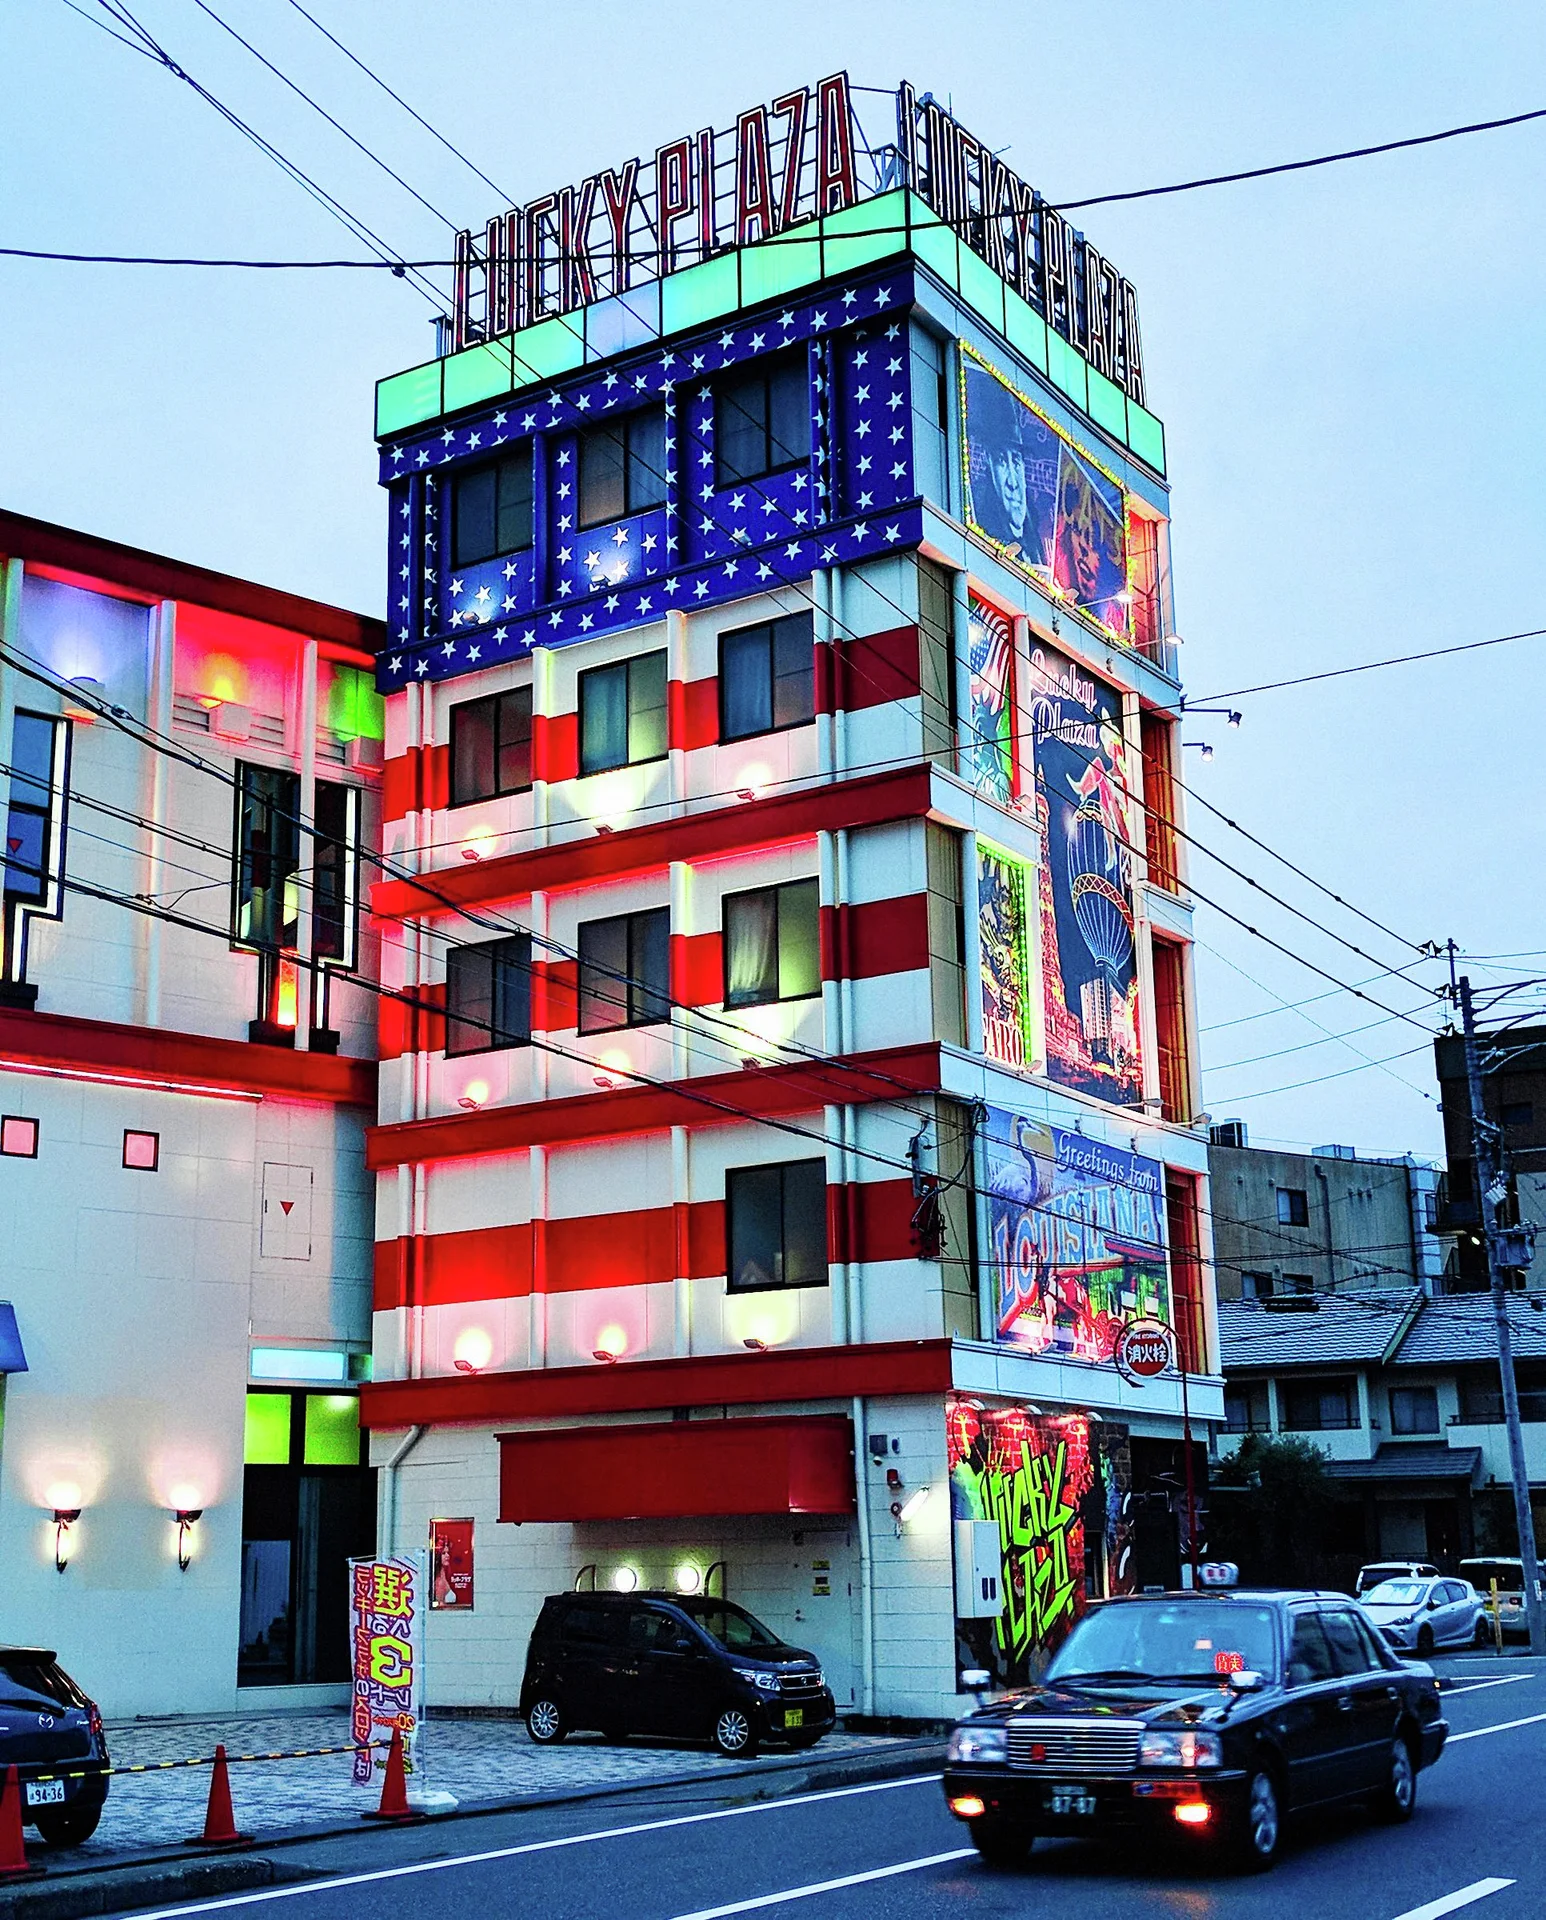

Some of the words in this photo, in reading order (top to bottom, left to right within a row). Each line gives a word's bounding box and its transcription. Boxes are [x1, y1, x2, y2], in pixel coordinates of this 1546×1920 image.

[452, 156, 639, 350] LUCKY
[654, 70, 858, 275] PLAZA
[900, 80, 1034, 302] LUCKY
[1041, 202, 1148, 408] PLAZA
[1030, 648, 1097, 714] Lucky
[1031, 696, 1100, 749] Plaza
[1055, 1132, 1125, 1190] Greetings
[1126, 1155, 1159, 1192] from
[993, 1187, 1163, 1324] LOUISIANA
[1127, 1343, 1167, 1363] 消火栓
[35, 1787, 63, 1802] 94-36
